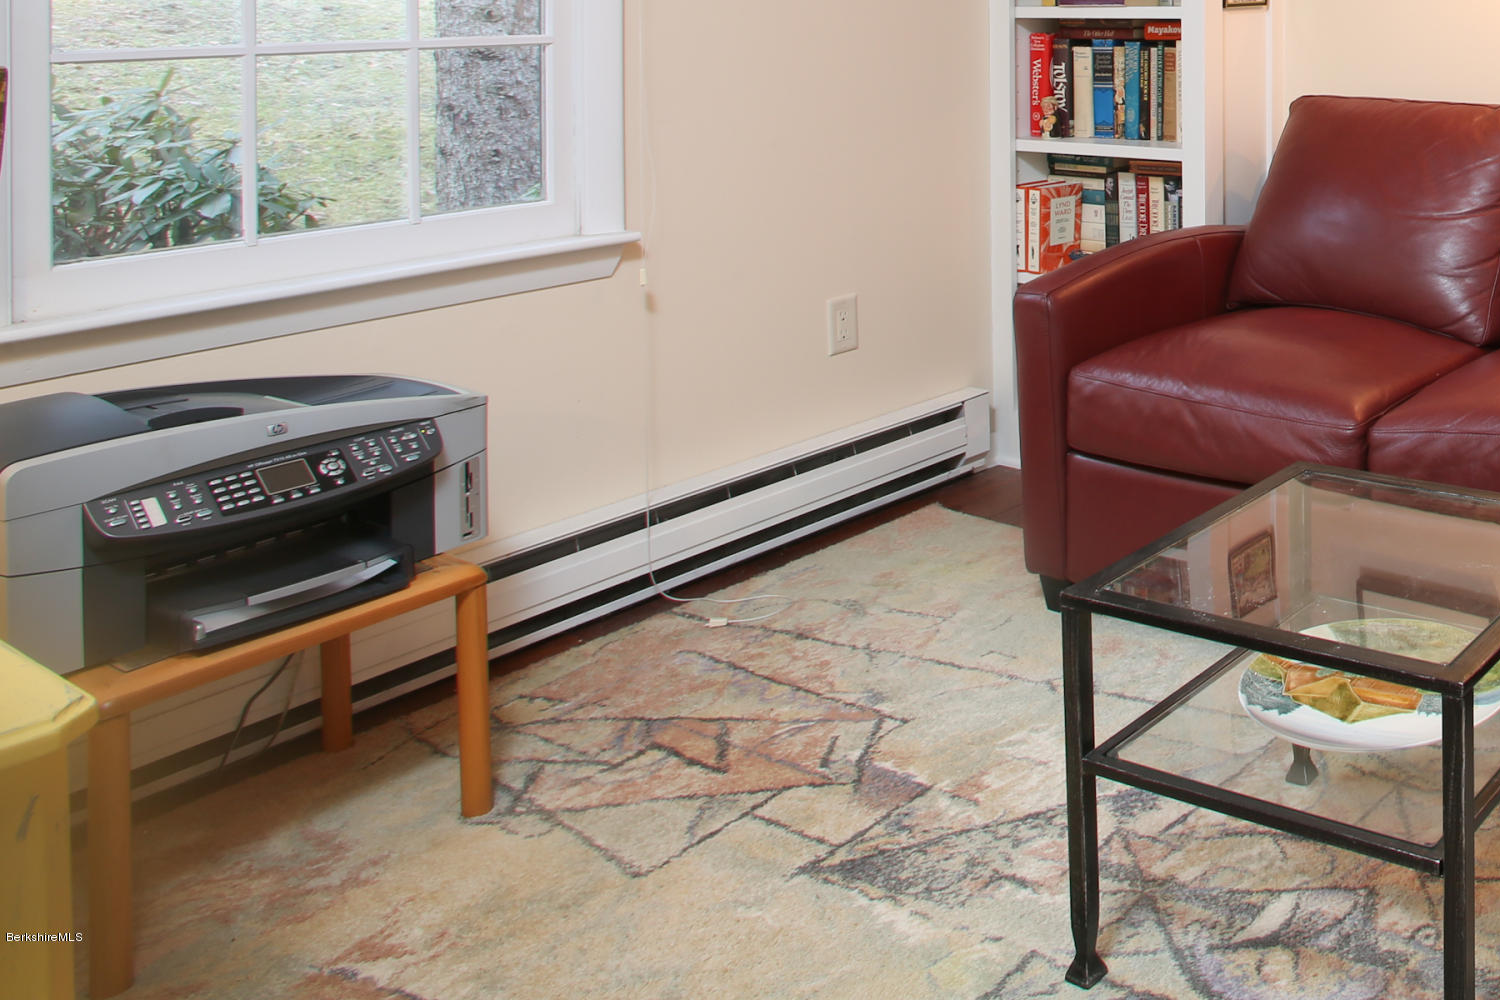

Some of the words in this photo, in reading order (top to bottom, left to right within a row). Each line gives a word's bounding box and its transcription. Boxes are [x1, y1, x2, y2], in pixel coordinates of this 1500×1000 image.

[1148, 25, 1181, 36] Mayakov
[1031, 58, 1042, 106] Webster's
[1053, 63, 1068, 112] TOLSTOY
[1055, 208, 1071, 216] WARD
